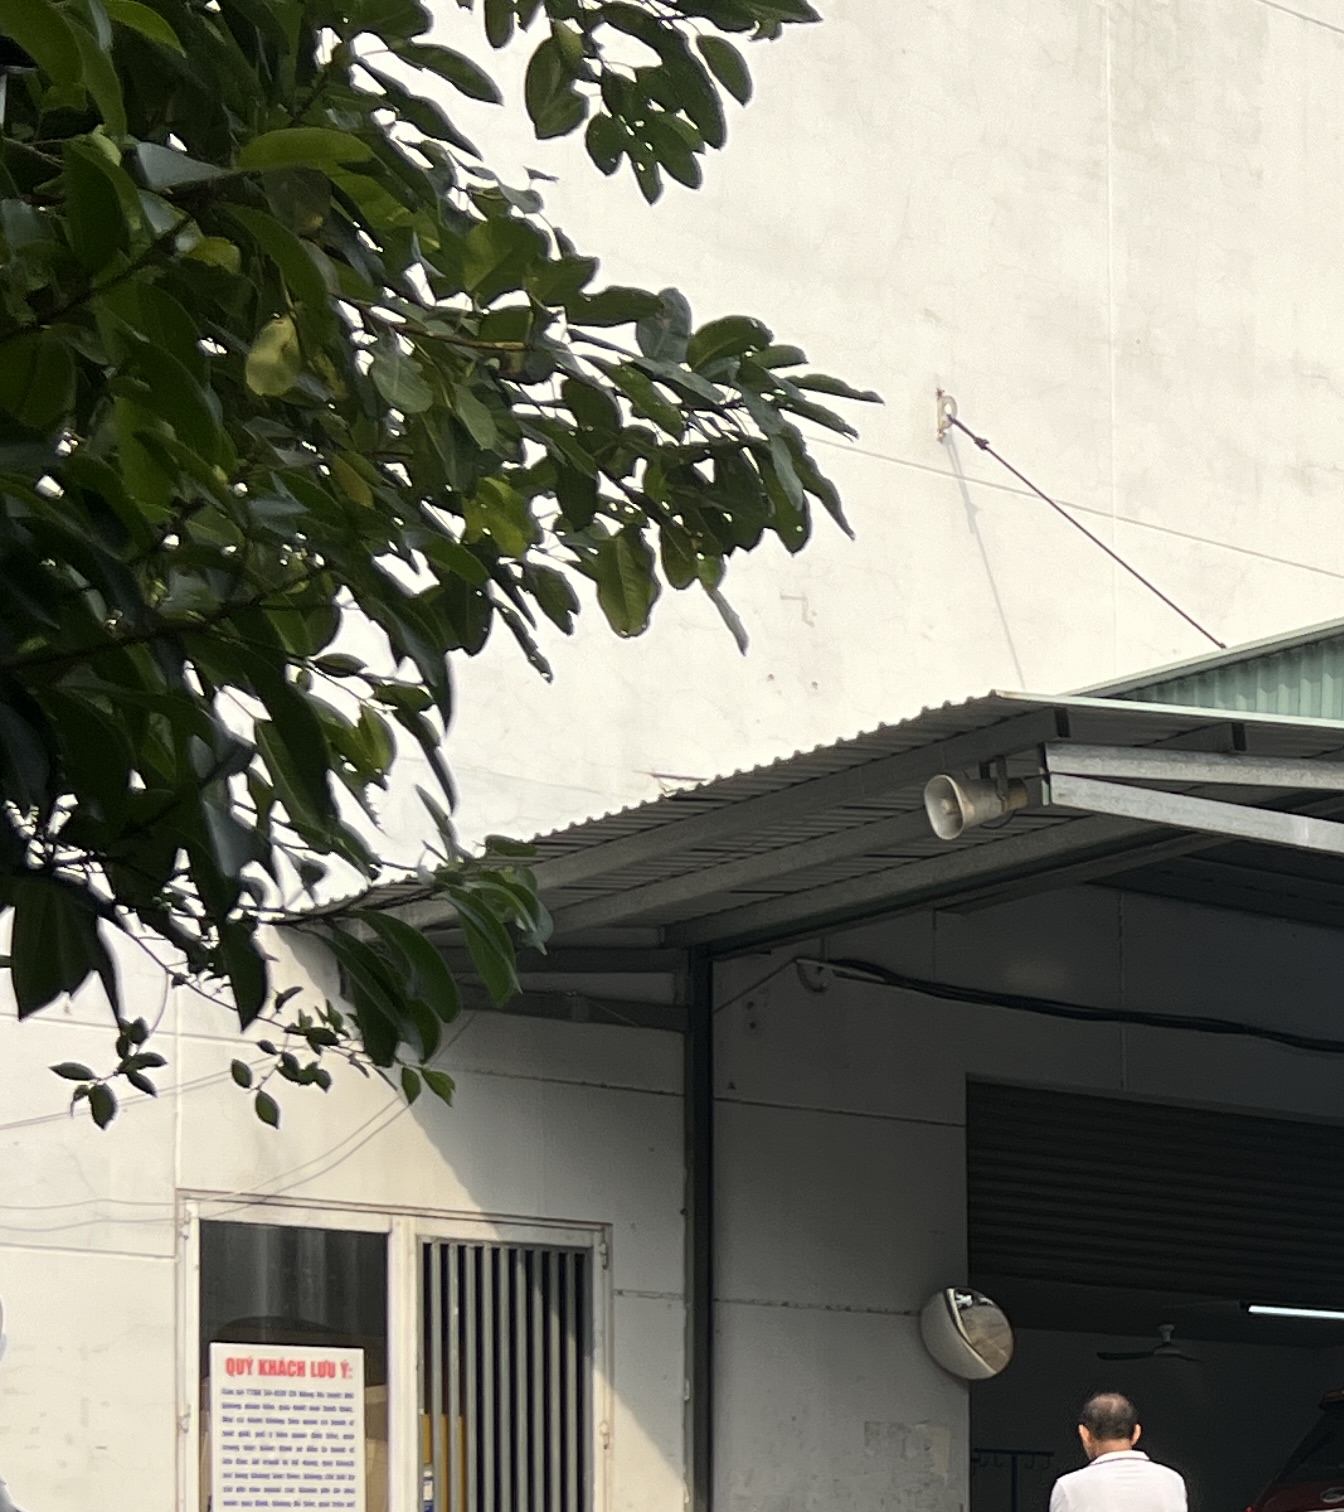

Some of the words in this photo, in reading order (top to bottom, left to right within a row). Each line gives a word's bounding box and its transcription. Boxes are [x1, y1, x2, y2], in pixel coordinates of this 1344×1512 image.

[225, 1355, 254, 1377] QUÝ
[258, 1356, 306, 1378] KHÁCH
[310, 1360, 336, 1379] LƯU
